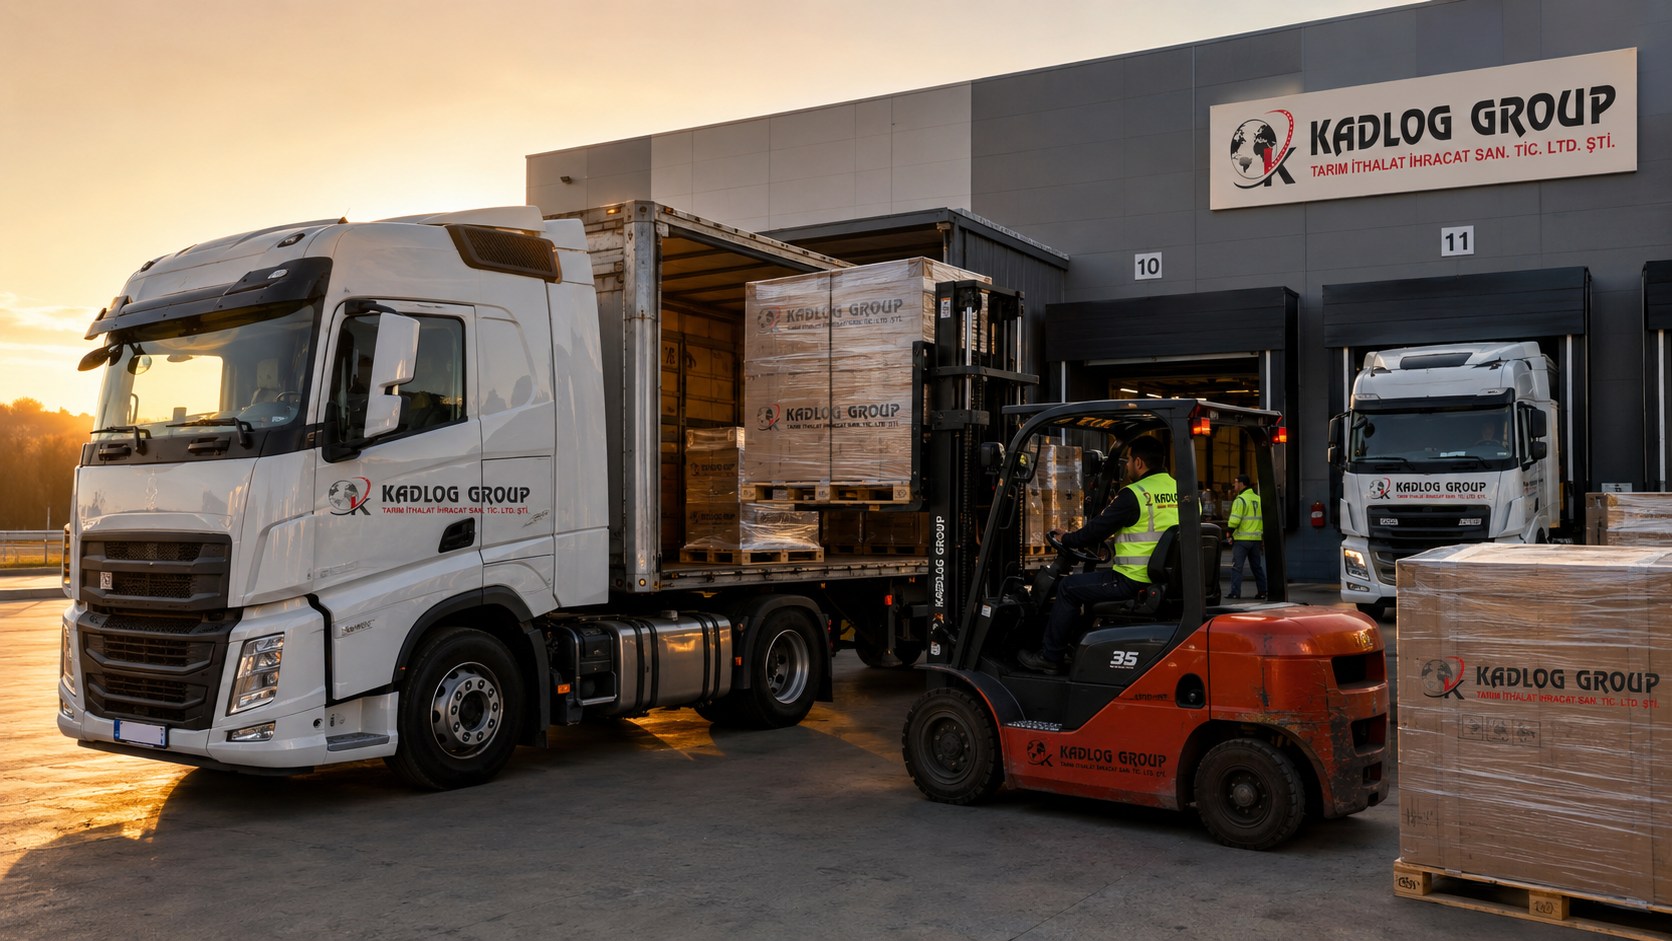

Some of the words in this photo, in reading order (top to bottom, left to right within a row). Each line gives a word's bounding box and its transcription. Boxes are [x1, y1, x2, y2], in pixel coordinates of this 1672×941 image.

[1311, 105, 1452, 157] KADLOG
[1471, 84, 1616, 138] GROUP
[1311, 162, 1348, 177] TARIM
[1351, 157, 1406, 174] İTHALAT
[1409, 150, 1471, 168] İHRACAT
[1475, 146, 1510, 161] SAN.
[1514, 141, 1542, 157] TİC.
[1547, 139, 1581, 154] LTD.
[1586, 132, 1615, 154] ŞTİ.
[1445, 231, 1469, 252] 11
[1137, 257, 1160, 276] 10
[849, 299, 903, 317] GROUP
[786, 406, 841, 422] KADLOG
[848, 403, 900, 419] GROUP
[382, 485, 459, 504] KADLOG
[468, 486, 530, 505] GROUP
[1396, 482, 1440, 493] KADLOG
[1445, 482, 1487, 493] GROUP
[935, 516, 945, 555] GROUP
[1110, 651, 1139, 666] 35
[1476, 666, 1565, 689] KADLOG
[1576, 670, 1660, 694] GROUP
[1060, 745, 1112, 763] KADLOG
[1118, 751, 1167, 768] GROUP
